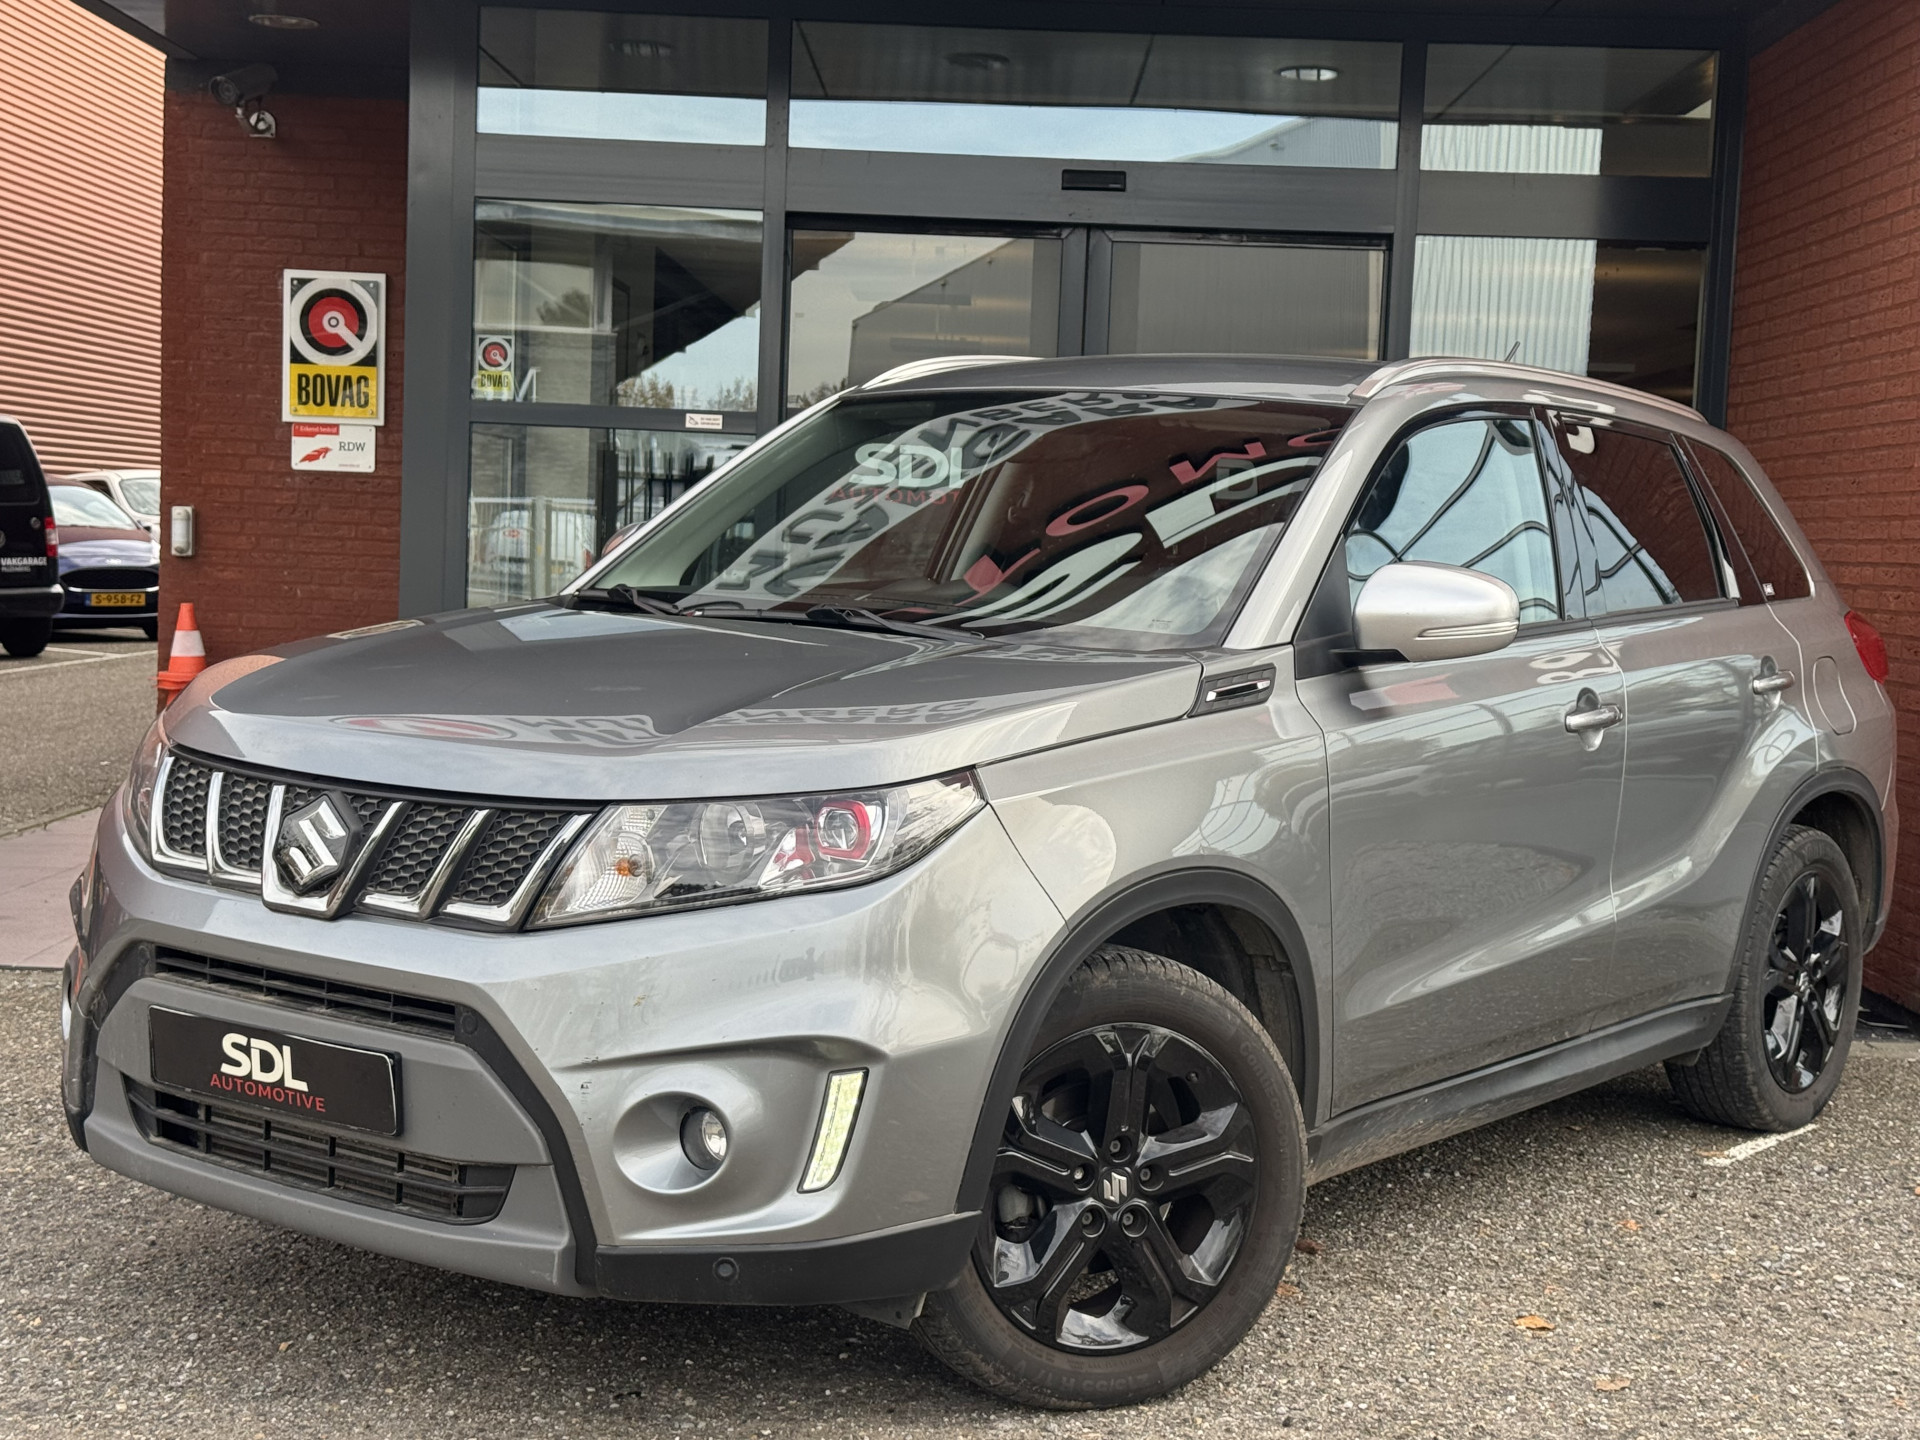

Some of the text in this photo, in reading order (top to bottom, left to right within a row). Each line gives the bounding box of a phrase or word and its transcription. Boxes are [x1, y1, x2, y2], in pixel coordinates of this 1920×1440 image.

[297, 373, 370, 408] BOVAG
[339, 441, 366, 452] RDW
[1, 556, 47, 566] VAKGARAGE
[220, 1032, 309, 1092] SDL
[210, 1073, 326, 1112] AUTOMOTIVE
